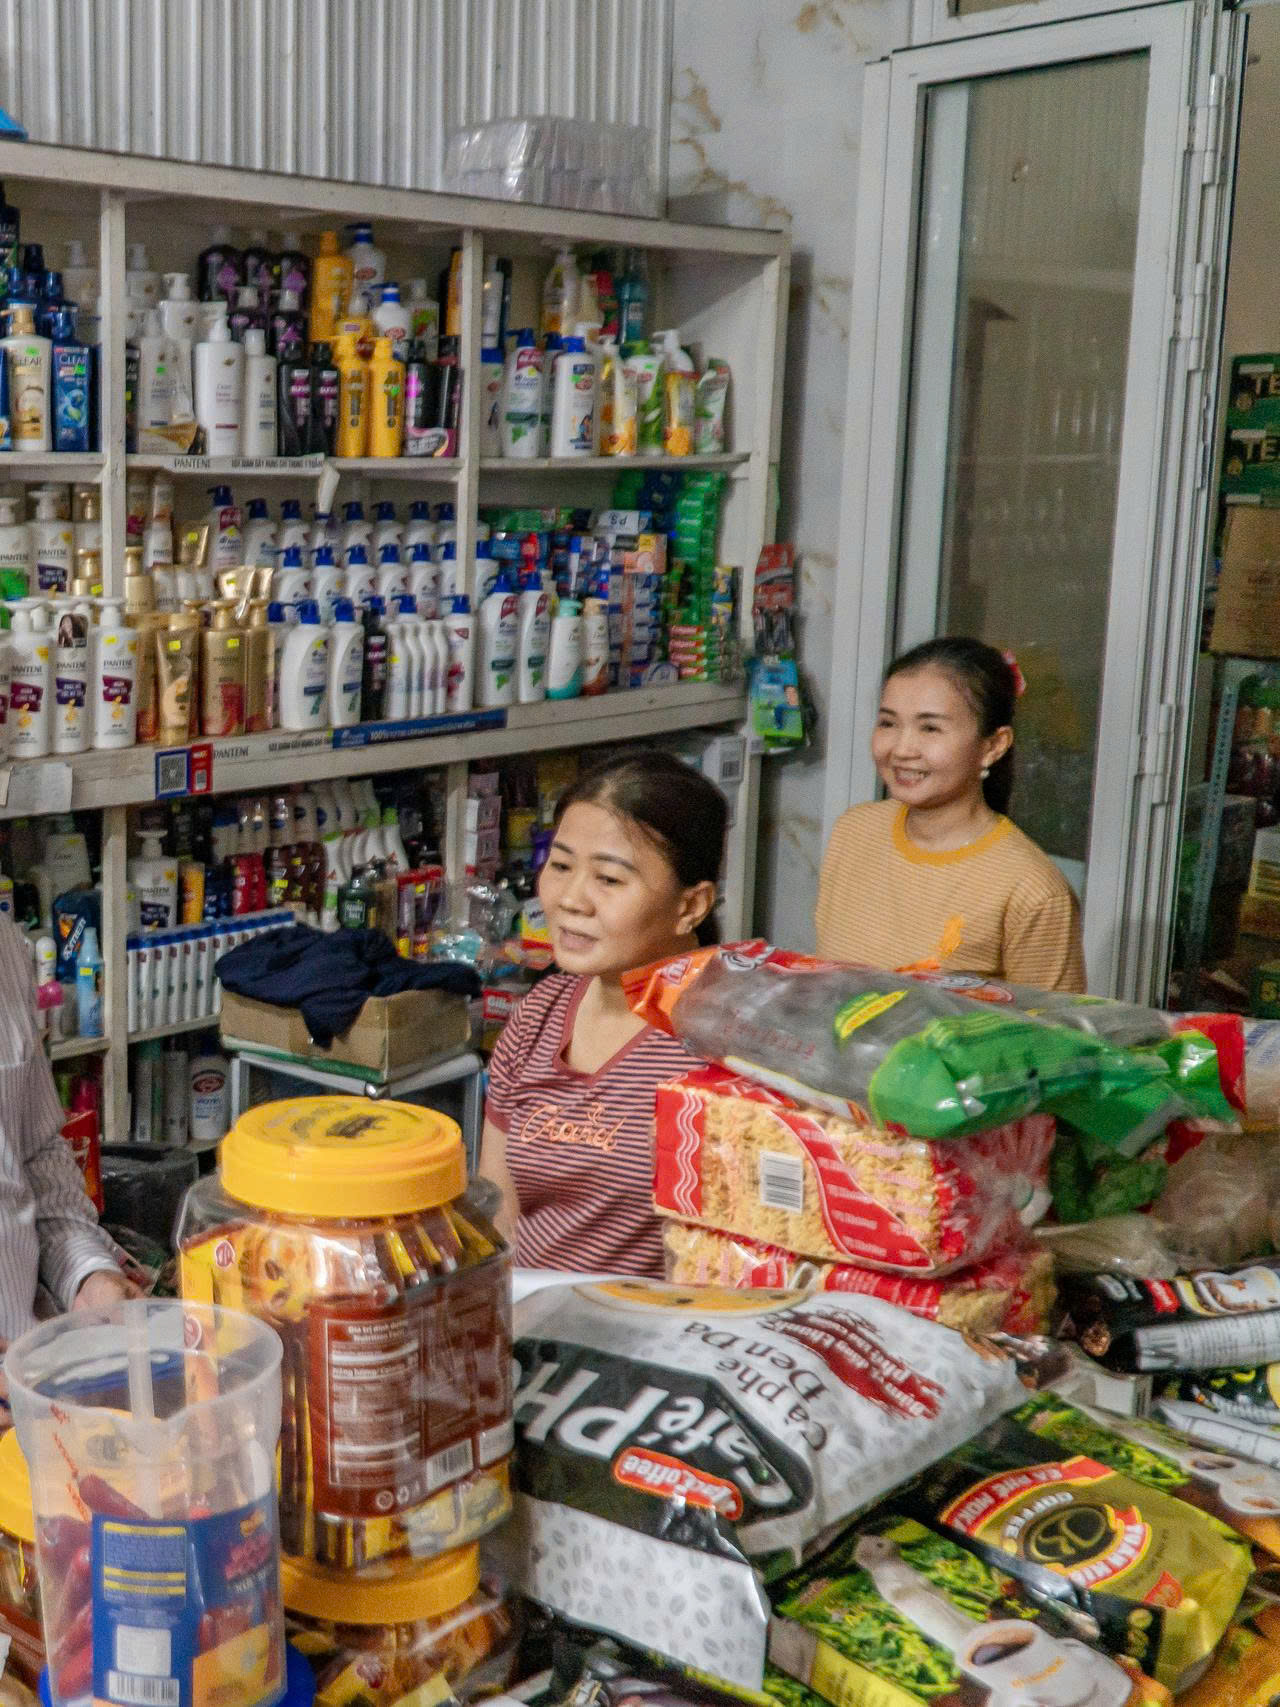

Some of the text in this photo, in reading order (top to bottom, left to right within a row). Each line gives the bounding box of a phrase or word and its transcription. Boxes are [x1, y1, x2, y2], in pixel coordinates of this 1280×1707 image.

[37, 549, 68, 559] PANTENE
[56, 662, 88, 670] PANTENE
[103, 659, 133, 668] PANTENE
[513, 1357, 795, 1506] Café PH
